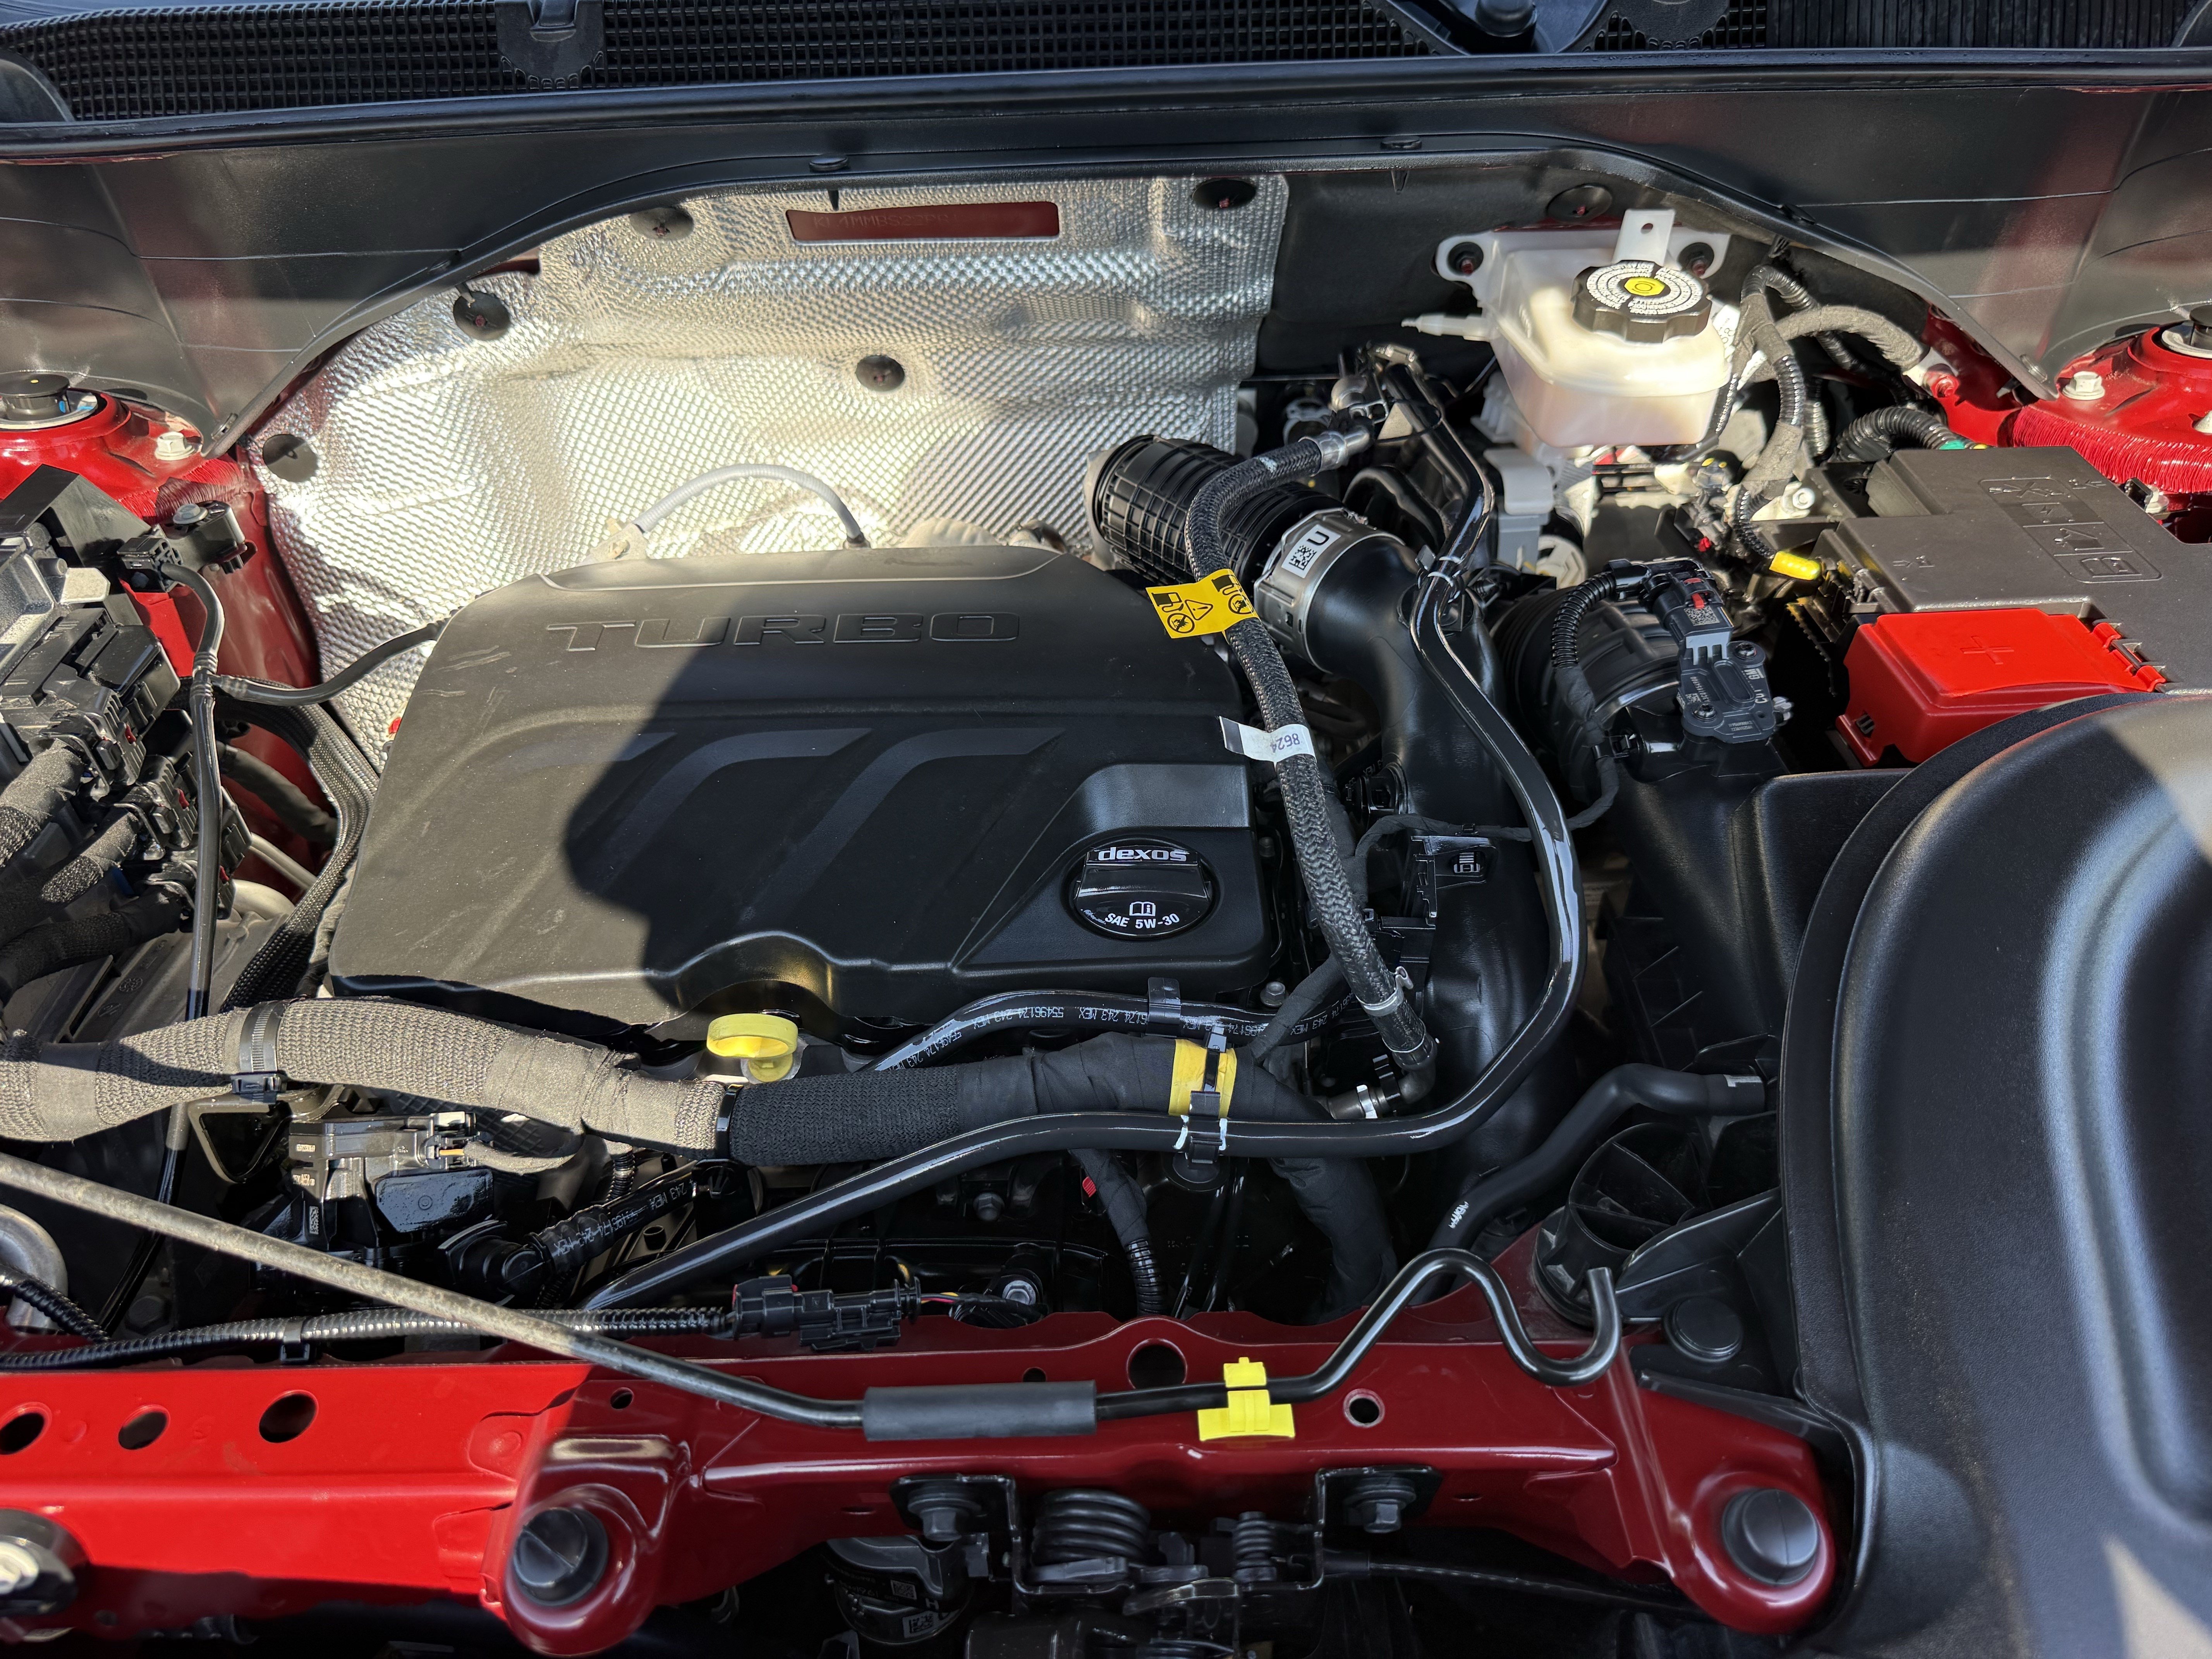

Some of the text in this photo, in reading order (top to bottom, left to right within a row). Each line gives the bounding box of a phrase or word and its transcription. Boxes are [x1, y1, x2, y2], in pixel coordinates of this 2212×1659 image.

[1307, 530, 1330, 546] U
[546, 611, 1020, 652] TURBO
[1270, 732, 1301, 753] 8624
[1097, 846, 1189, 862] dexos
[1105, 913, 1180, 929] SAE 5W-30
[1018, 1006, 1065, 1019] 55496174
[1101, 1010, 1119, 1022] 243
[1290, 1022, 1309, 1036] MEX
[670, 1182, 687, 1200] 243
[649, 1192, 668, 1211] MEX
